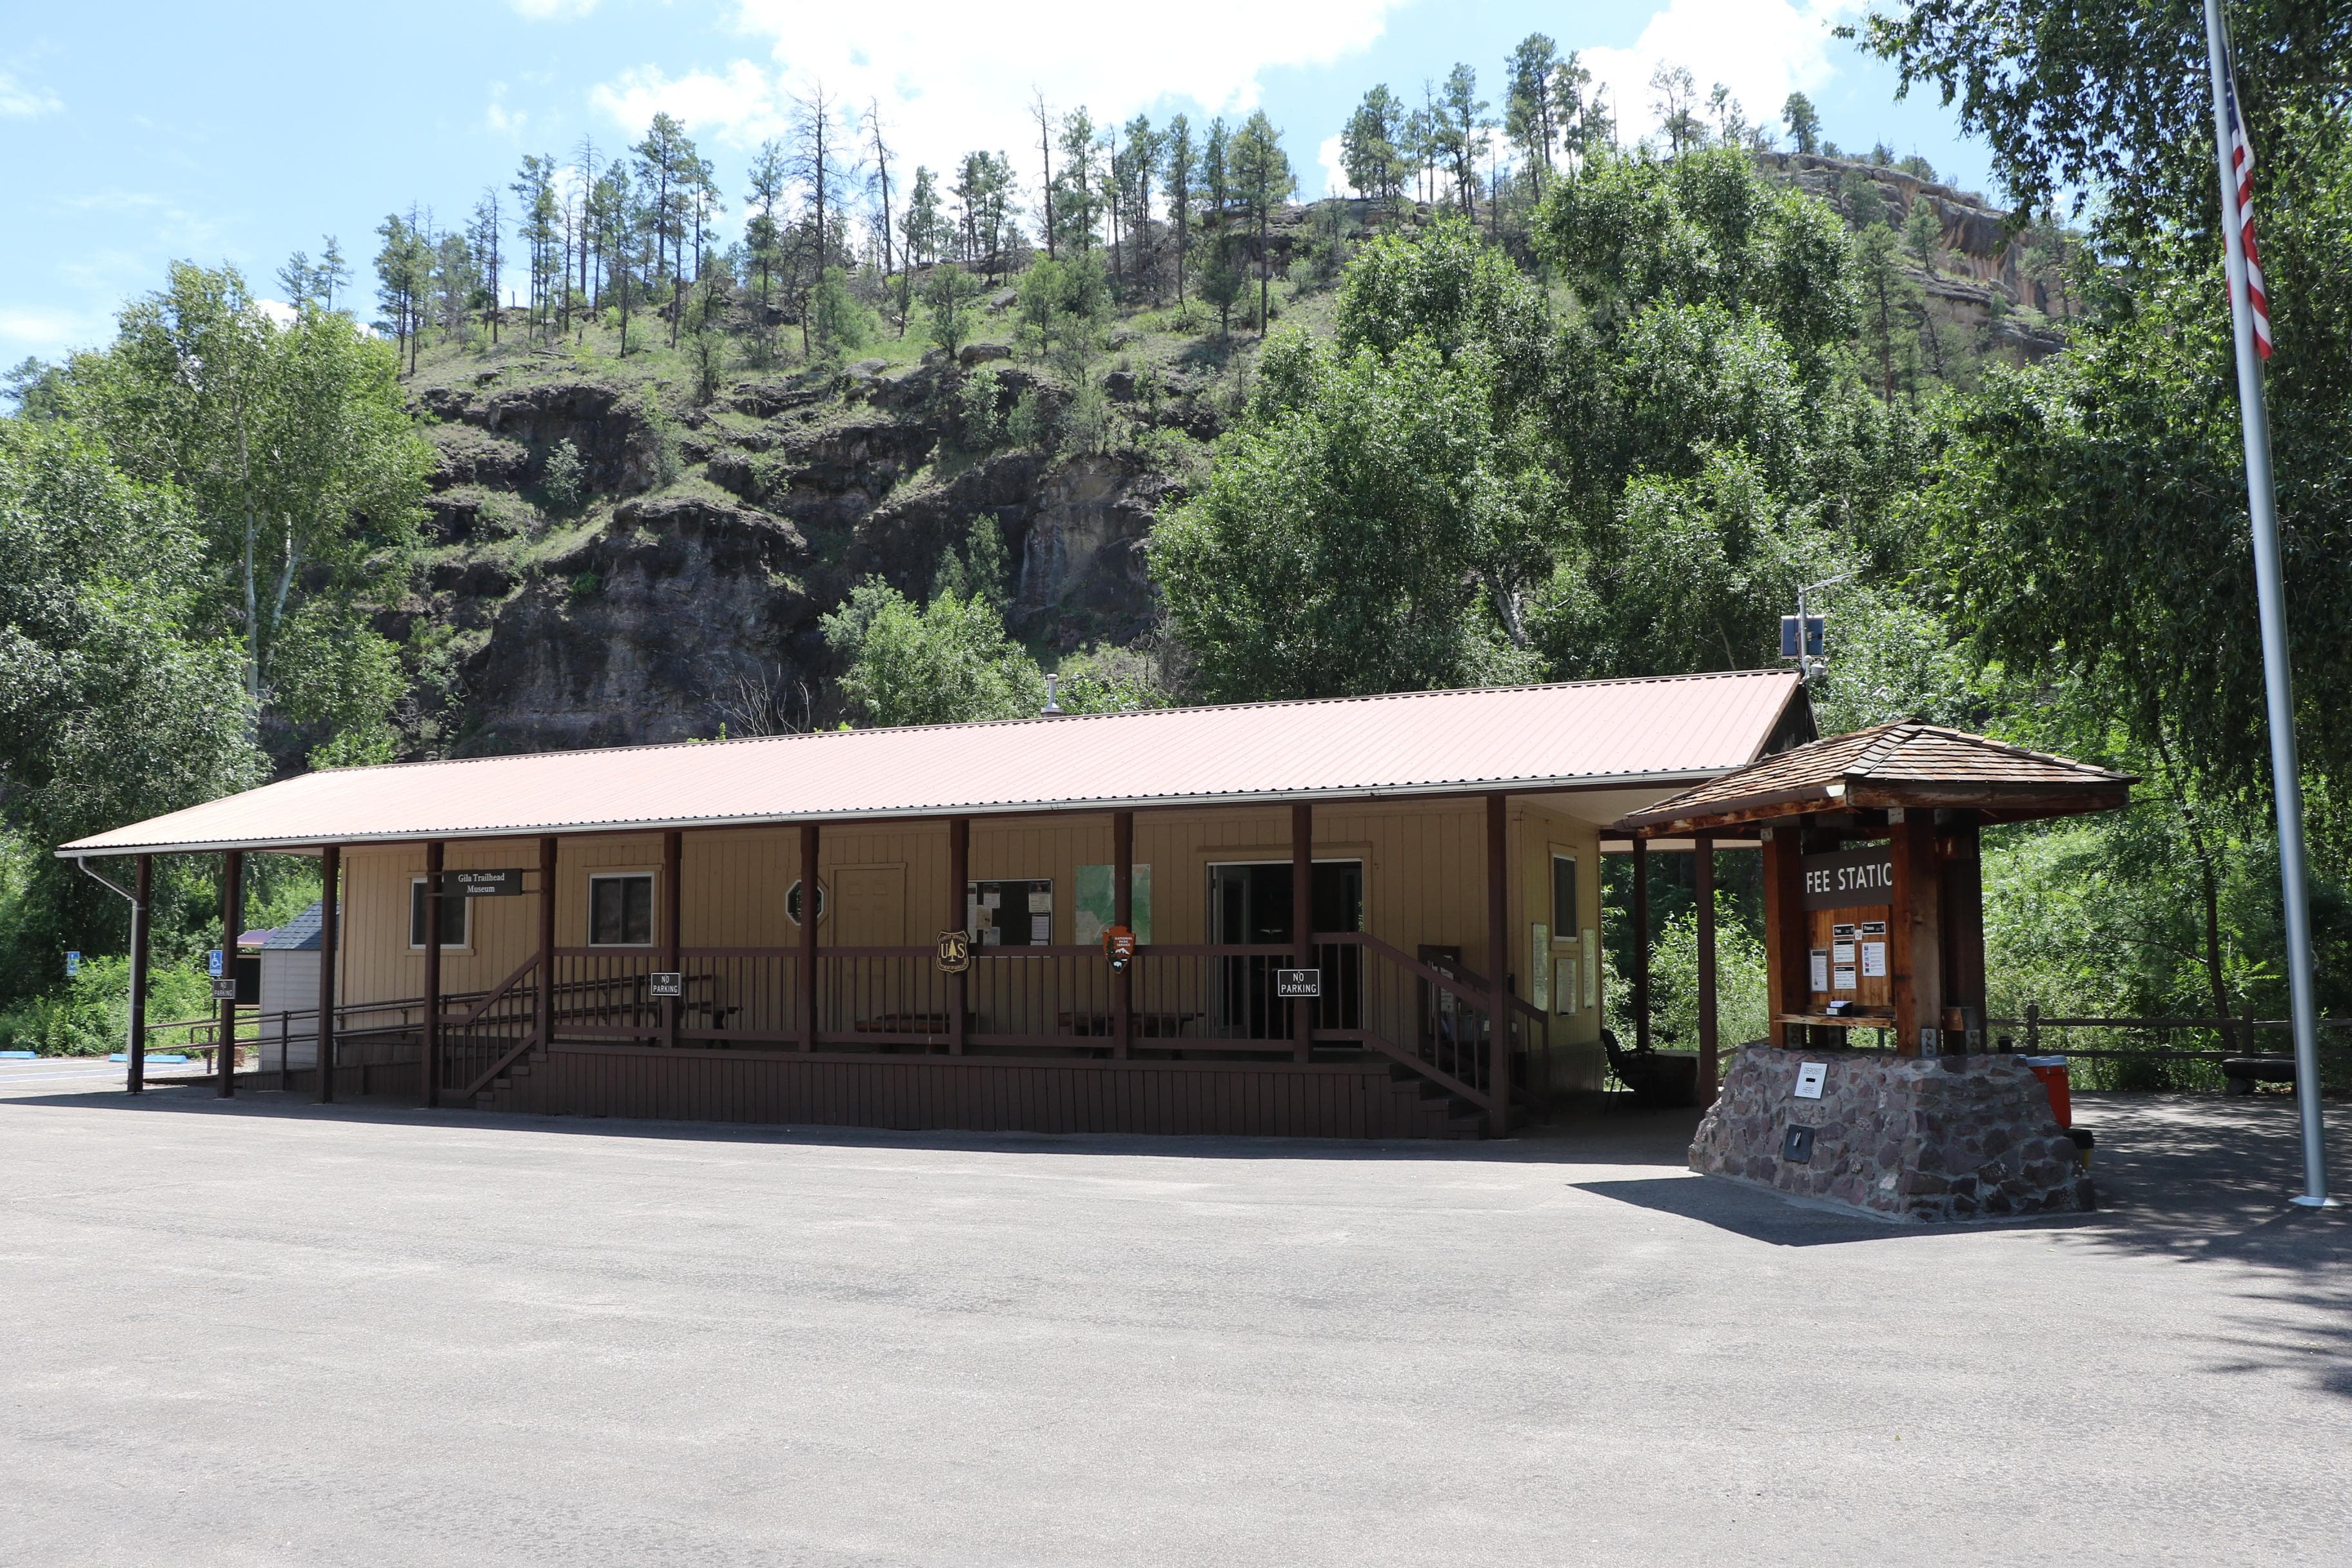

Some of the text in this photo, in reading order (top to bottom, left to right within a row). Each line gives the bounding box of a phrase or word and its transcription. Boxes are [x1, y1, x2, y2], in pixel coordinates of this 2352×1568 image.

[458, 873, 505, 883] Gila Trailhead
[1807, 870, 1830, 894] FEE
[661, 975, 670, 984] NO
[1293, 972, 1304, 982] NO
[652, 985, 678, 994] PARKING
[1281, 984, 1317, 994] PARKING
[1803, 1067, 1823, 1075] DEPOSIT
